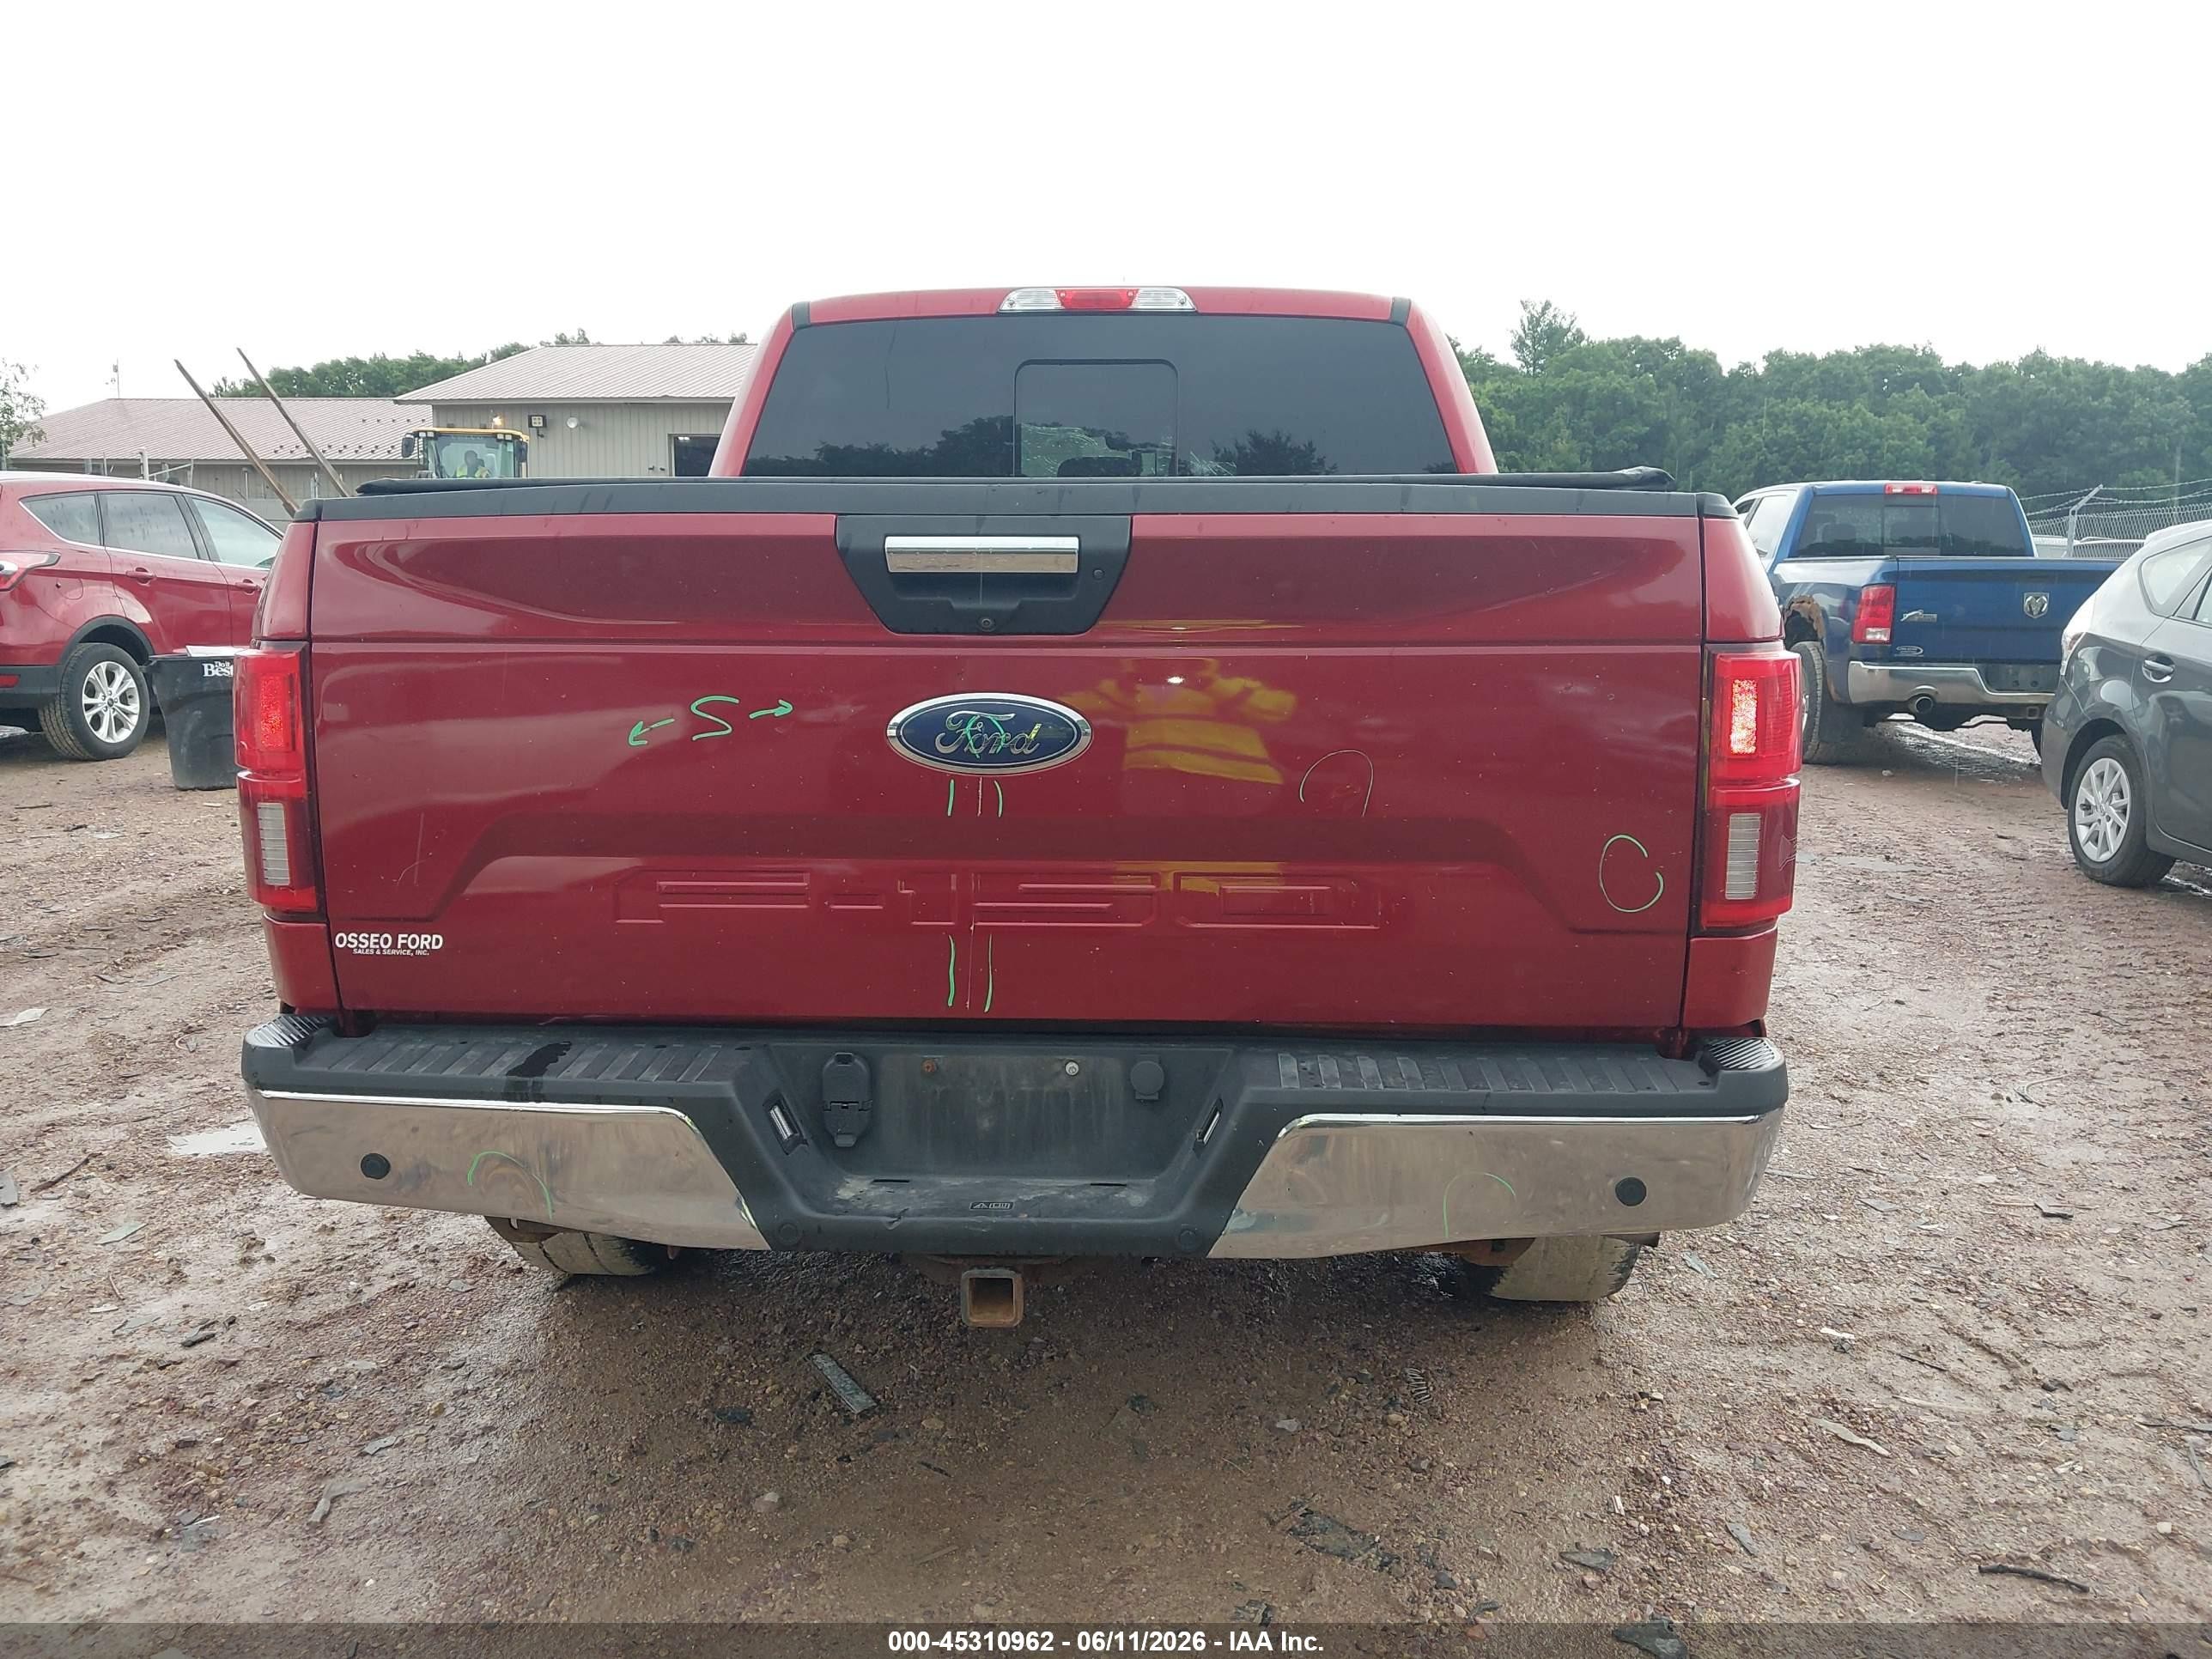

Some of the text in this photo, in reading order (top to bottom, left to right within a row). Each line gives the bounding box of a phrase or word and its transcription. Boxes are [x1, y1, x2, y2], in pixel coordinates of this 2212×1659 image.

[934, 710, 1042, 755] Ford
[335, 933, 444, 950] OSSEO FORD
[383, 948, 414, 957] SERVICE,
